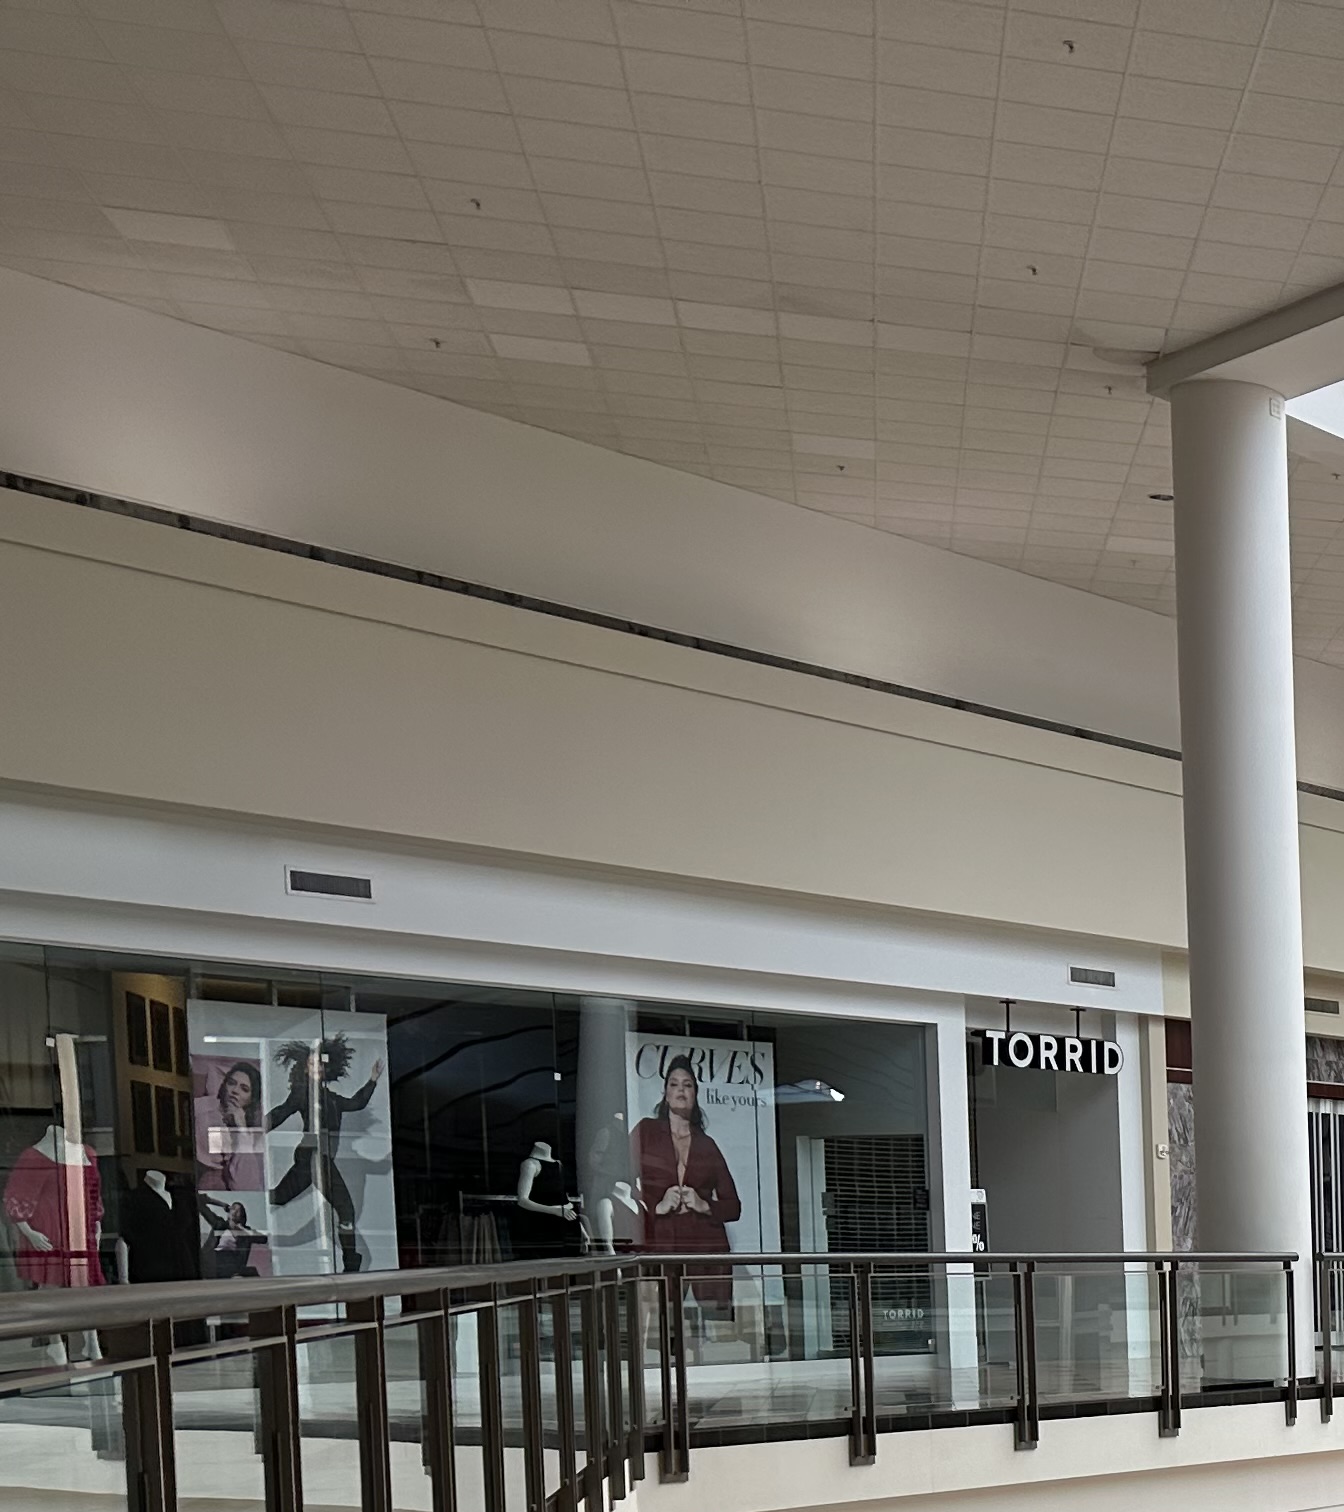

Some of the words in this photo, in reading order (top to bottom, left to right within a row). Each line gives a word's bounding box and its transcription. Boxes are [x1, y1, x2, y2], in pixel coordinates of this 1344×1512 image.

[635, 1042, 766, 1086] CURVES
[985, 1029, 1125, 1075] TORRID
[706, 1087, 729, 1106] like
[730, 1093, 767, 1112] yours
[882, 1308, 925, 1321] TORRID
